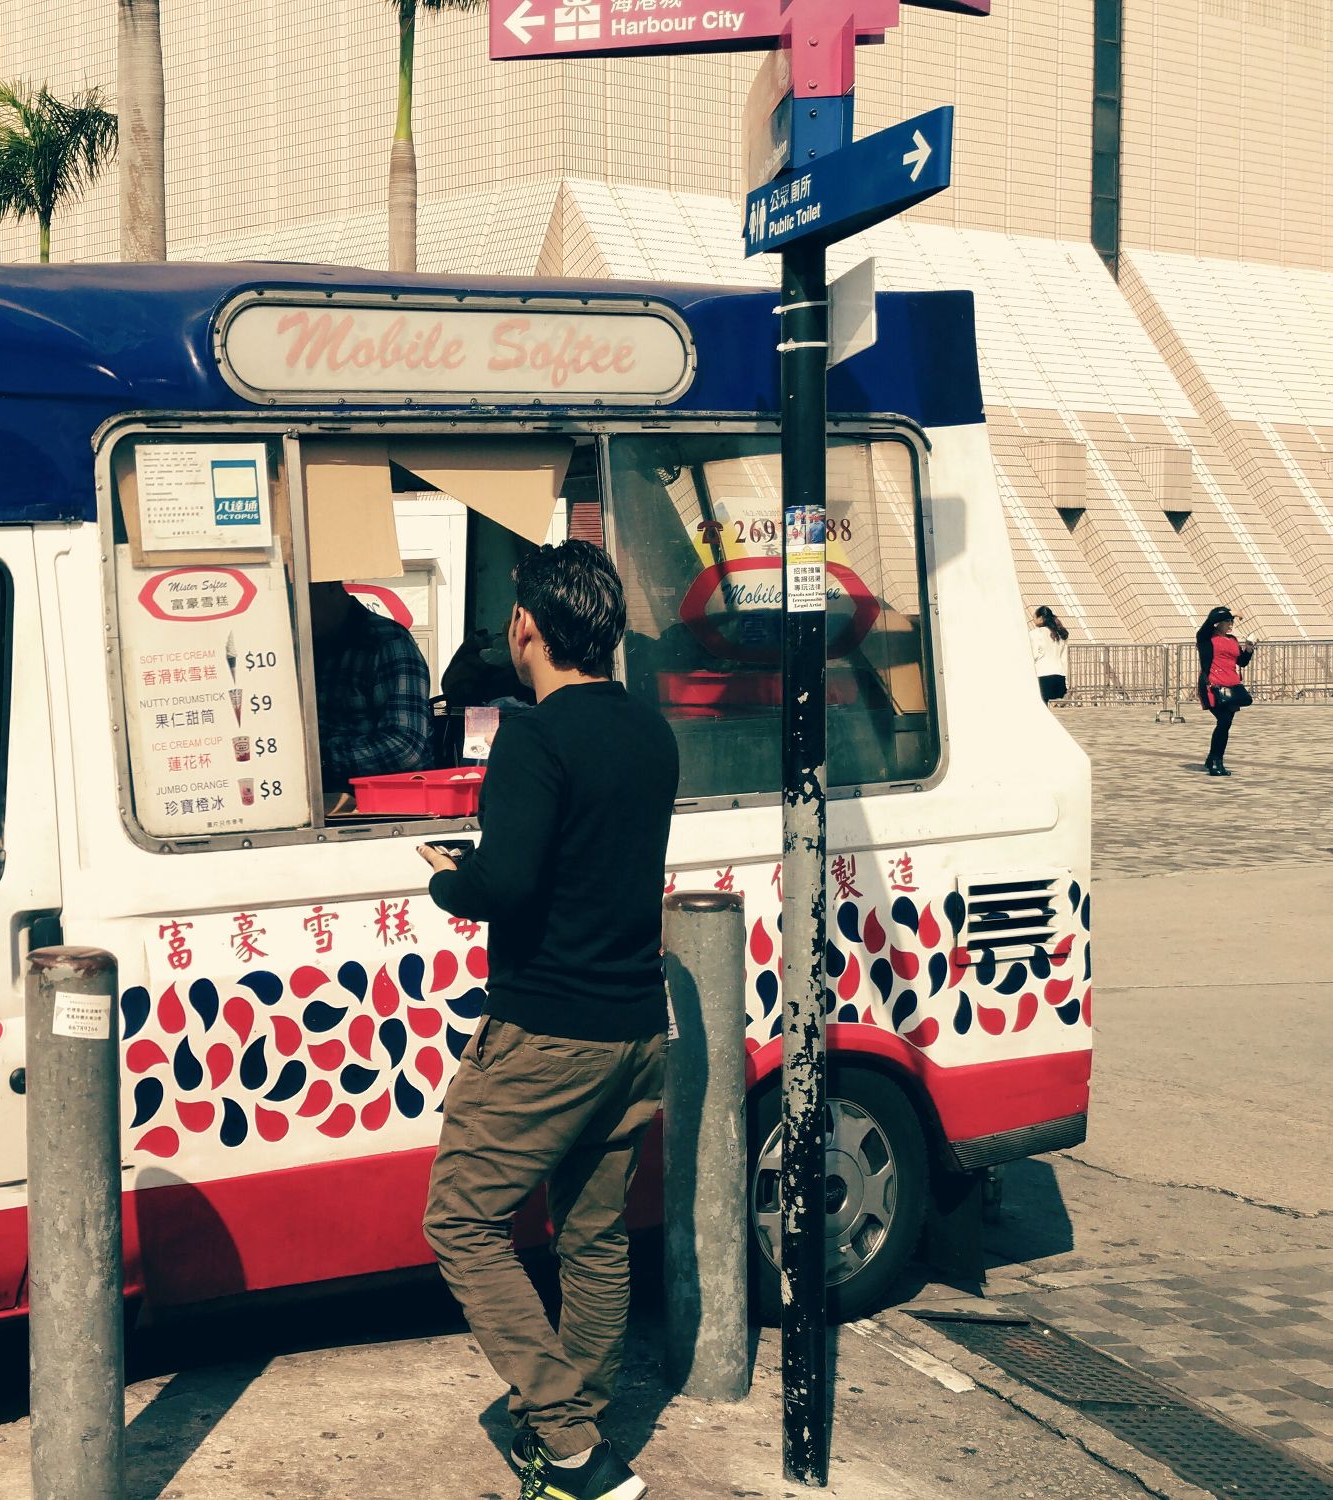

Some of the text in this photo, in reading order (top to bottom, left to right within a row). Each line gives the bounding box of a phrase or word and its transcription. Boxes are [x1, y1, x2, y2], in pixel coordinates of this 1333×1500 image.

[611, 10, 745, 36] Harbour City
[768, 202, 821, 238] Public Toilet
[277, 311, 636, 388] Mobile Softee
[217, 500, 259, 513] 八達通
[216, 513, 260, 521] OCTOPUS
[733, 518, 852, 544] 26988
[168, 579, 228, 592] Mister Softee
[721, 582, 783, 605] Mobile
[140, 650, 215, 664] SOFT ICE CREAM
[245, 651, 277, 672] $10
[142, 665, 218, 686] 香滑軟雪糕
[140, 692, 225, 709] NUTTY DRUMSTICK
[250, 694, 272, 714] $9
[155, 709, 215, 729] 果仁甜筒
[152, 737, 223, 752] ICE CREAM CUP
[255, 737, 277, 757] $8
[168, 753, 212, 772] 蓮花杯
[156, 780, 229, 796] JUMBO ORANGE
[260, 780, 283, 800] $8
[165, 795, 225, 816] 珍寶橙冰
